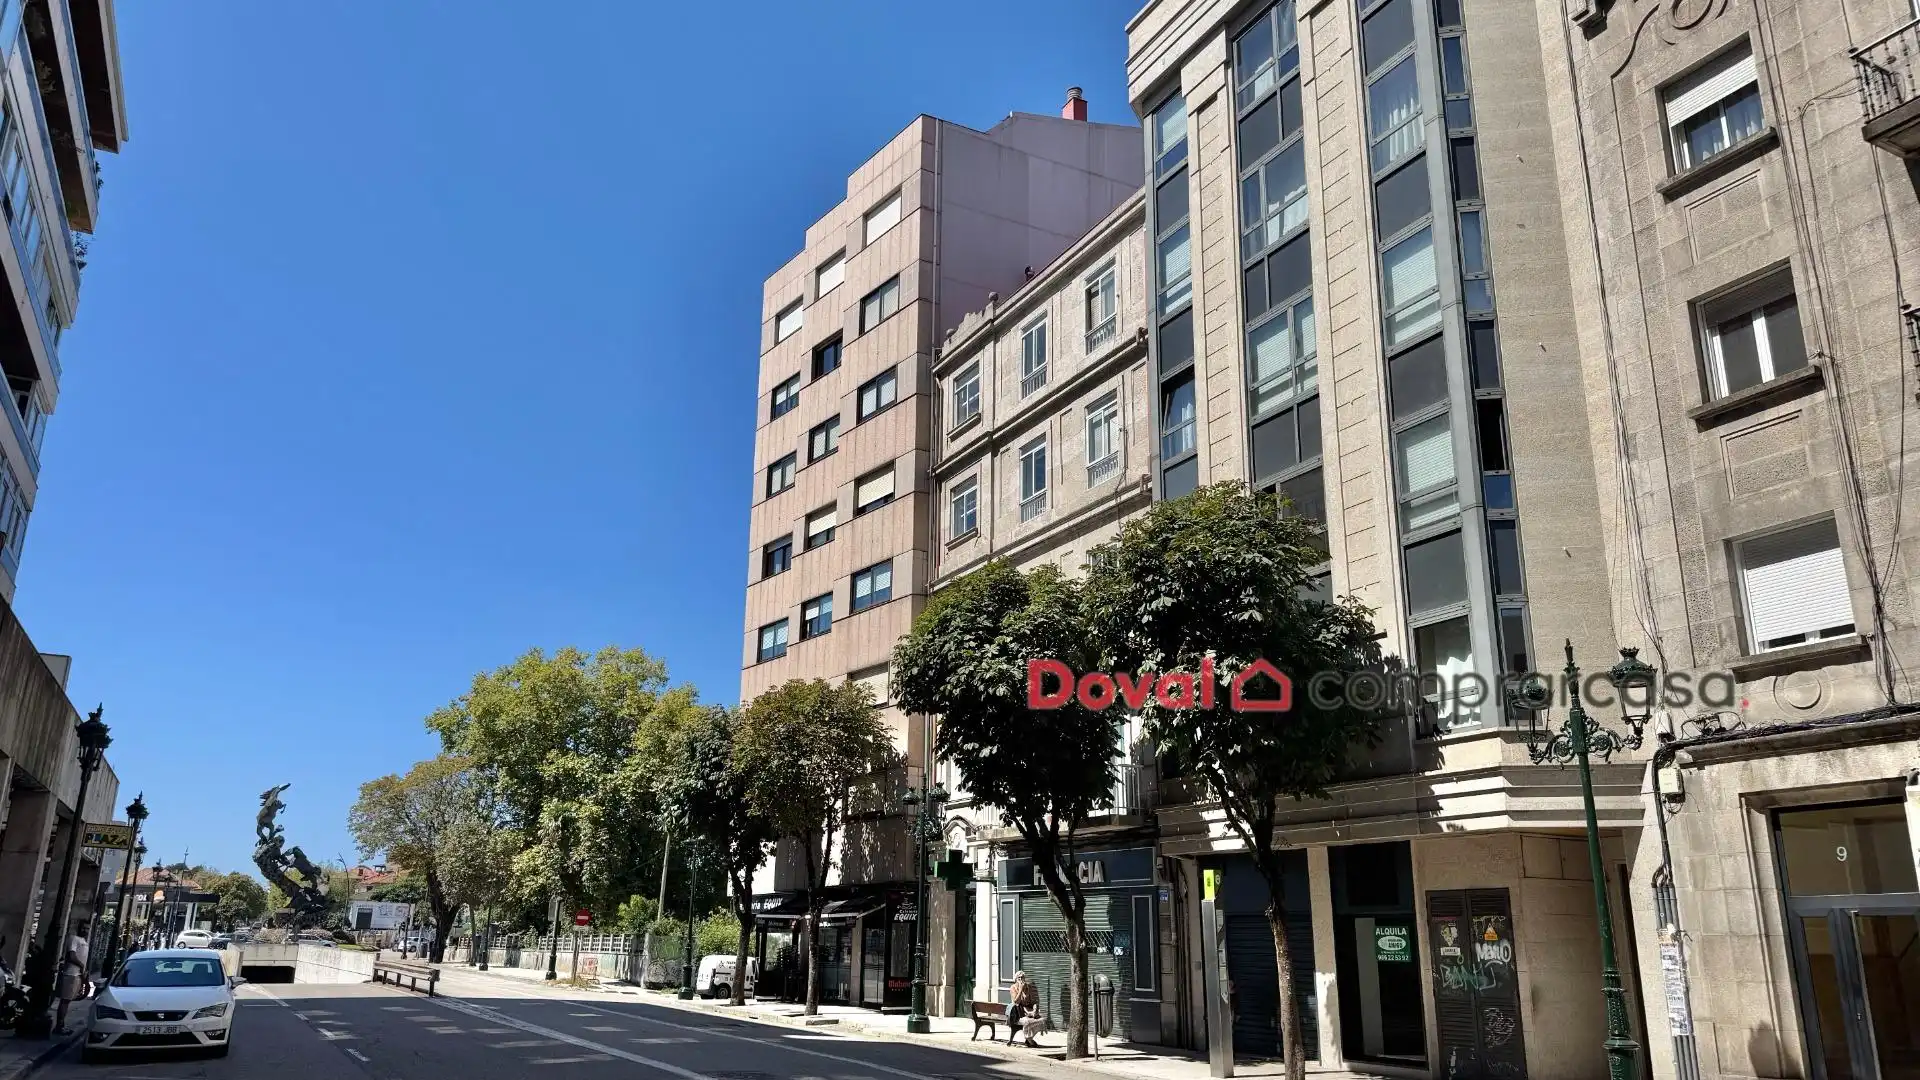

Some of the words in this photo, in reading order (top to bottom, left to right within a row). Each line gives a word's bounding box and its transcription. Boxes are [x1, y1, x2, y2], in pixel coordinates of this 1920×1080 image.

[84, 833, 128, 846] PLAZA
[1836, 846, 1848, 861] 9
[1033, 860, 1105, 886] FCIA
[894, 913, 918, 922] EQUIX
[1375, 927, 1408, 936] ALQUILA
